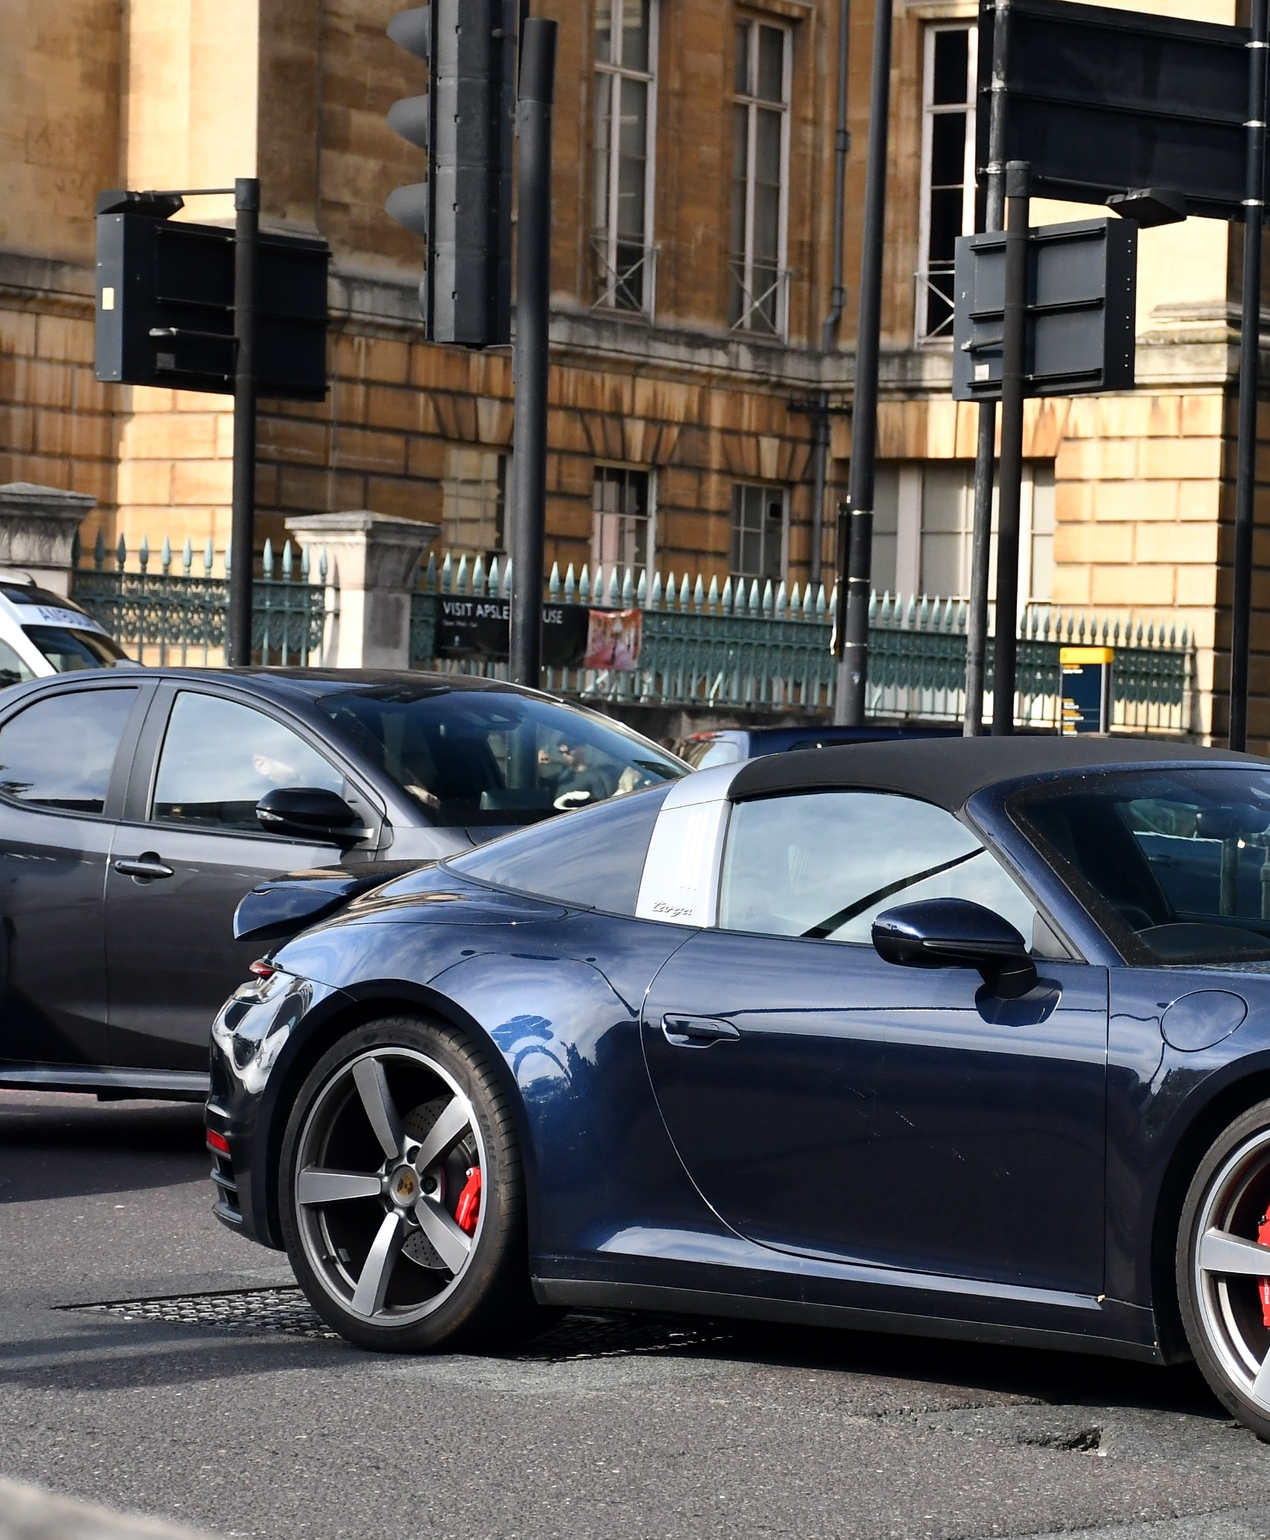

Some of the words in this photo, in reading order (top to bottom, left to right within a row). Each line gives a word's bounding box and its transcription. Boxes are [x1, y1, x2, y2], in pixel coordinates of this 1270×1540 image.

[442, 601, 473, 617] VISIT
[476, 603, 509, 620] APSLE
[542, 609, 563, 625] USE
[480, 1113, 498, 1163] EAGLE
